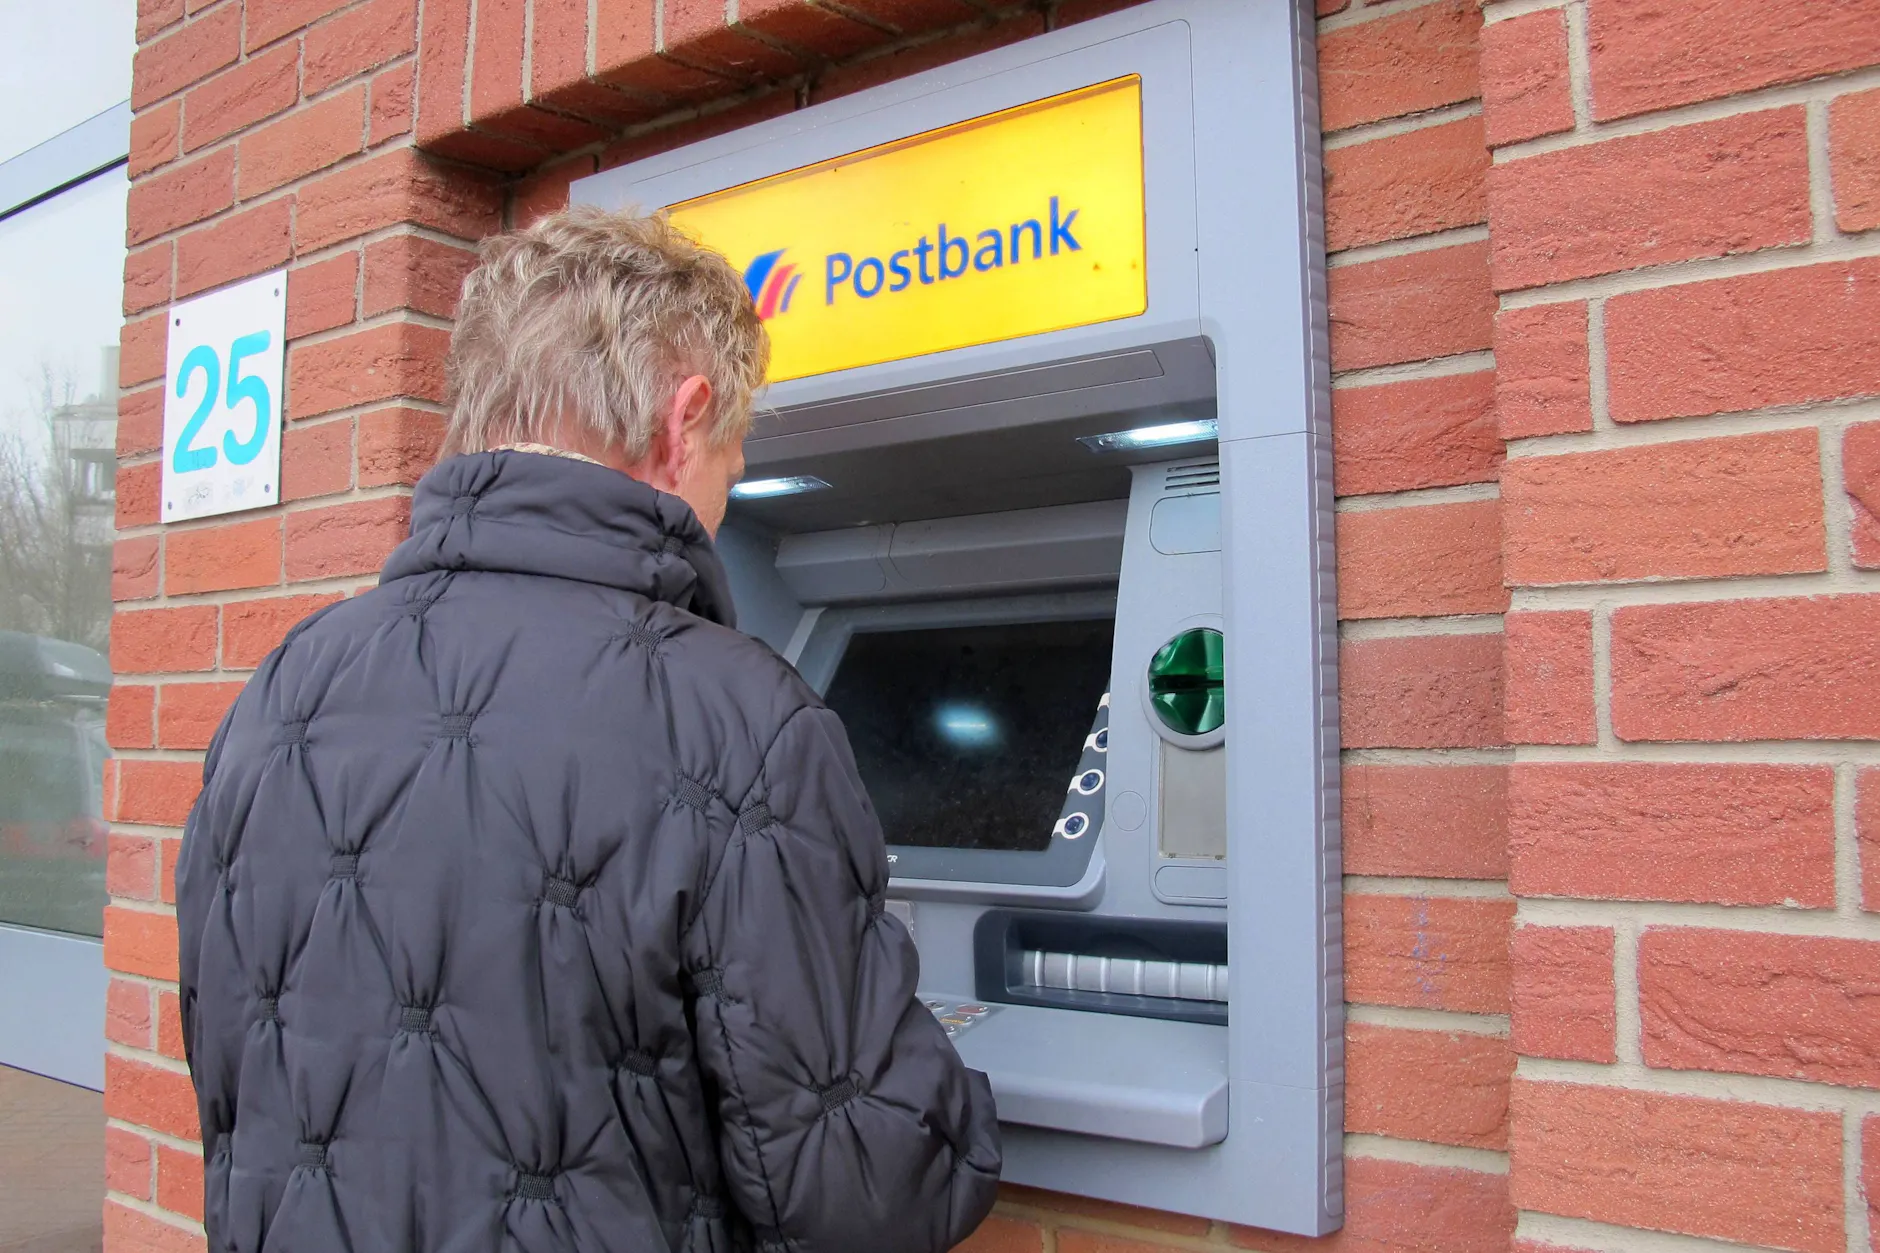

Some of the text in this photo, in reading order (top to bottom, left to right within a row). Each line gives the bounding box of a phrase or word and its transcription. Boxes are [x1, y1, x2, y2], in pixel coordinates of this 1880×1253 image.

[825, 196, 1082, 305] Postbank
[173, 330, 271, 473] 25
[886, 854, 898, 863] CR
